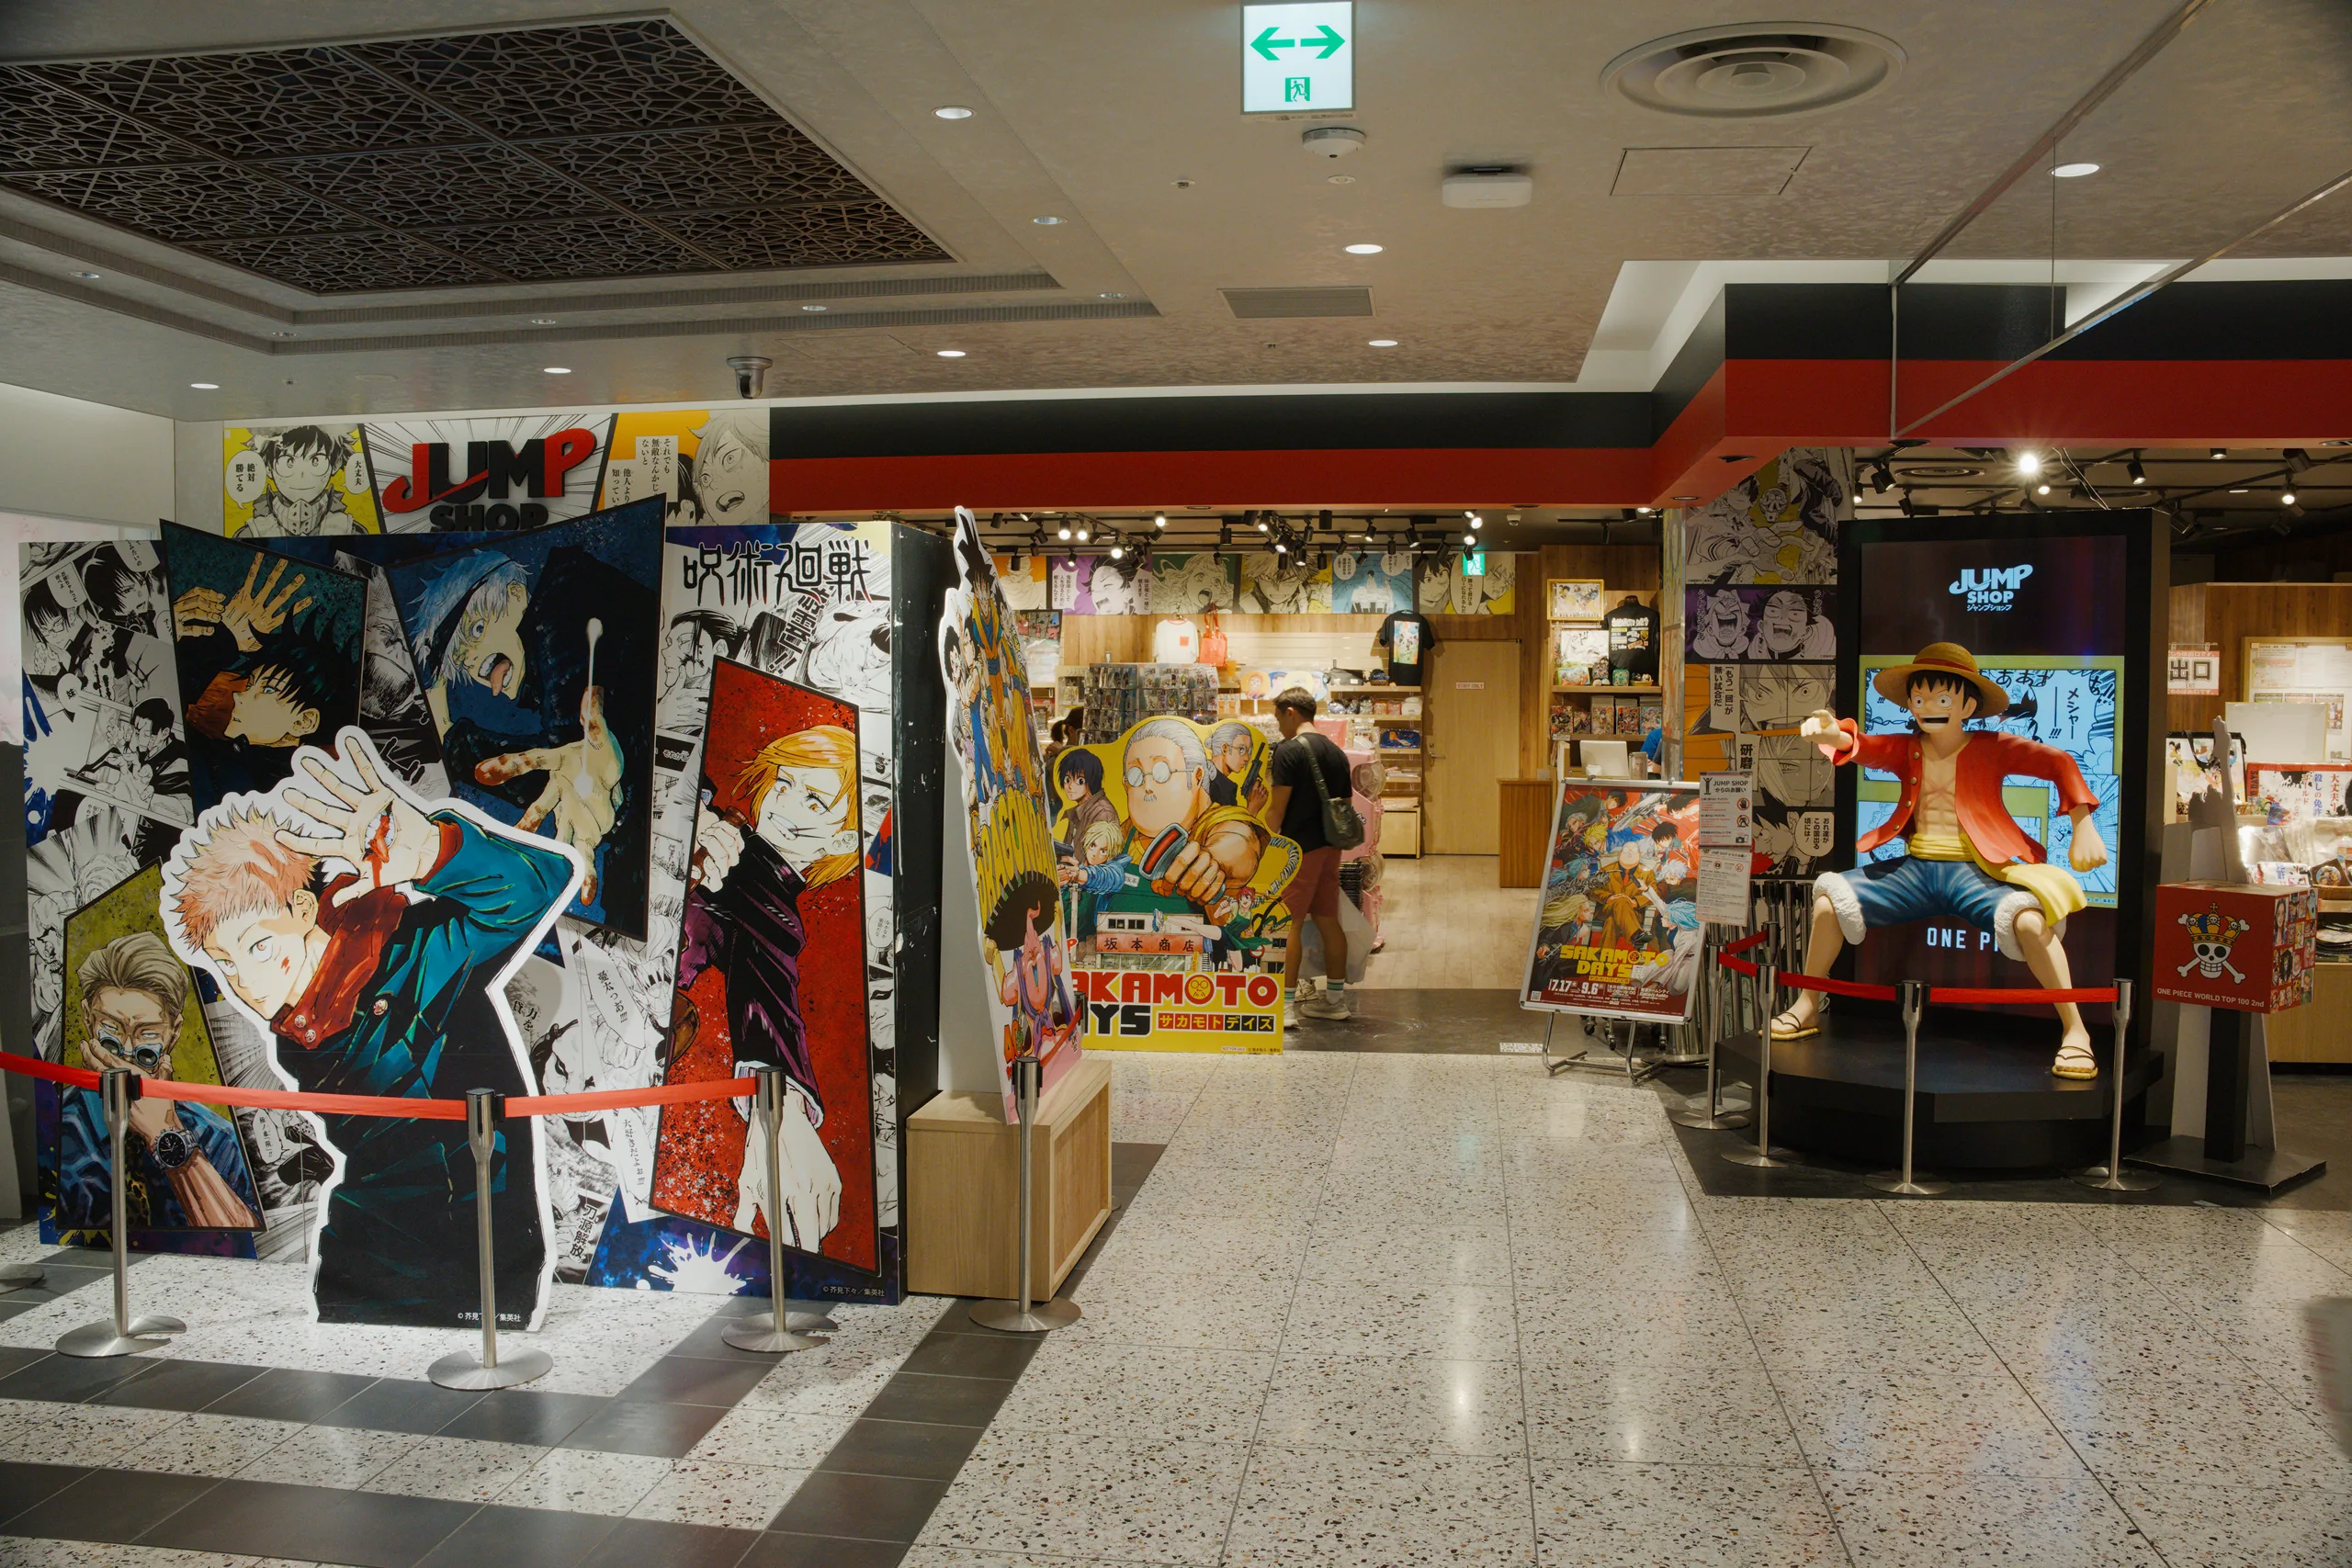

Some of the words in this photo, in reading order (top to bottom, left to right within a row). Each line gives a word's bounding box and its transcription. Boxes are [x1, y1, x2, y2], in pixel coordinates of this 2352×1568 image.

[651, 438, 660, 495] 無敵なんかじ
[663, 438, 672, 474] それでも
[235, 463, 243, 492] 勝てる
[247, 463, 255, 482] 絶対
[355, 460, 363, 486] 大丈夫
[382, 428, 597, 513] JUMP
[612, 468, 620, 506] 知ってい
[623, 468, 632, 502] 他人より
[429, 502, 548, 533] SHOP
[683, 539, 873, 608] 呪術廻戦
[1949, 564, 2033, 594] JUMP
[1967, 591, 2014, 604] SHOP
[1967, 604, 2013, 612] ジャンプショップ
[2170, 659, 2211, 682] 出口
[1713, 666, 1723, 706] 無い試合だ
[1724, 666, 1734, 715] 「もう一回」が
[1740, 743, 1753, 770] 研磨
[1104, 937, 1195, 952] 坂本商店
[1927, 927, 1967, 950] ONE
[1560, 944, 1669, 967] SAKAMOTO
[1577, 961, 1633, 978] DAYS
[1581, 982, 1599, 995] 9.6
[2156, 987, 2171, 996] ONE
[2173, 989, 2192, 998] PIECE
[2194, 992, 2221, 1002] WORLD
[2237, 998, 2250, 1006] 100
[2251, 998, 2265, 1008] 2nd
[1159, 1014, 1273, 1031] サカモトデイズ
[458, 1312, 521, 1323] ©芥見／集英社
